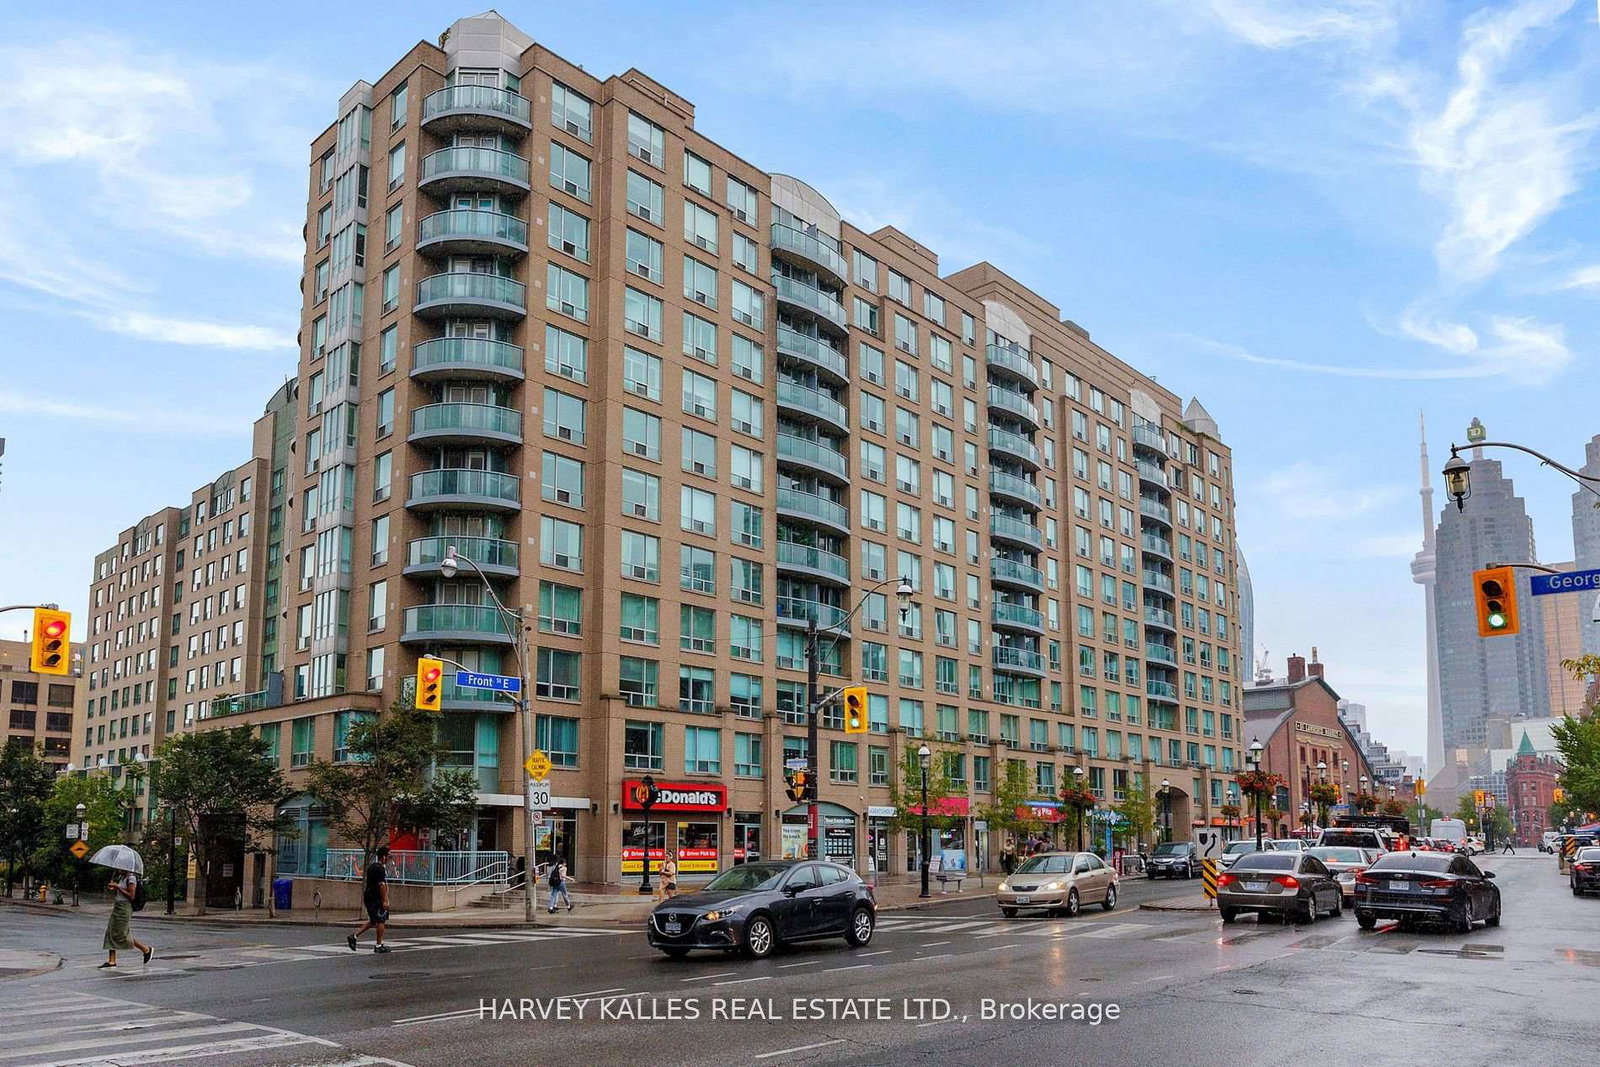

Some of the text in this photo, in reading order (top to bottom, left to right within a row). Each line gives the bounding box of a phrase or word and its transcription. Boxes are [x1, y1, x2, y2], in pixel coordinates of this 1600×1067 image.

[1469, 428, 1481, 436] TD
[468, 675, 493, 687] Front
[503, 679, 509, 689] E
[533, 791, 549, 805] 30
[655, 790, 717, 805] cDonald's
